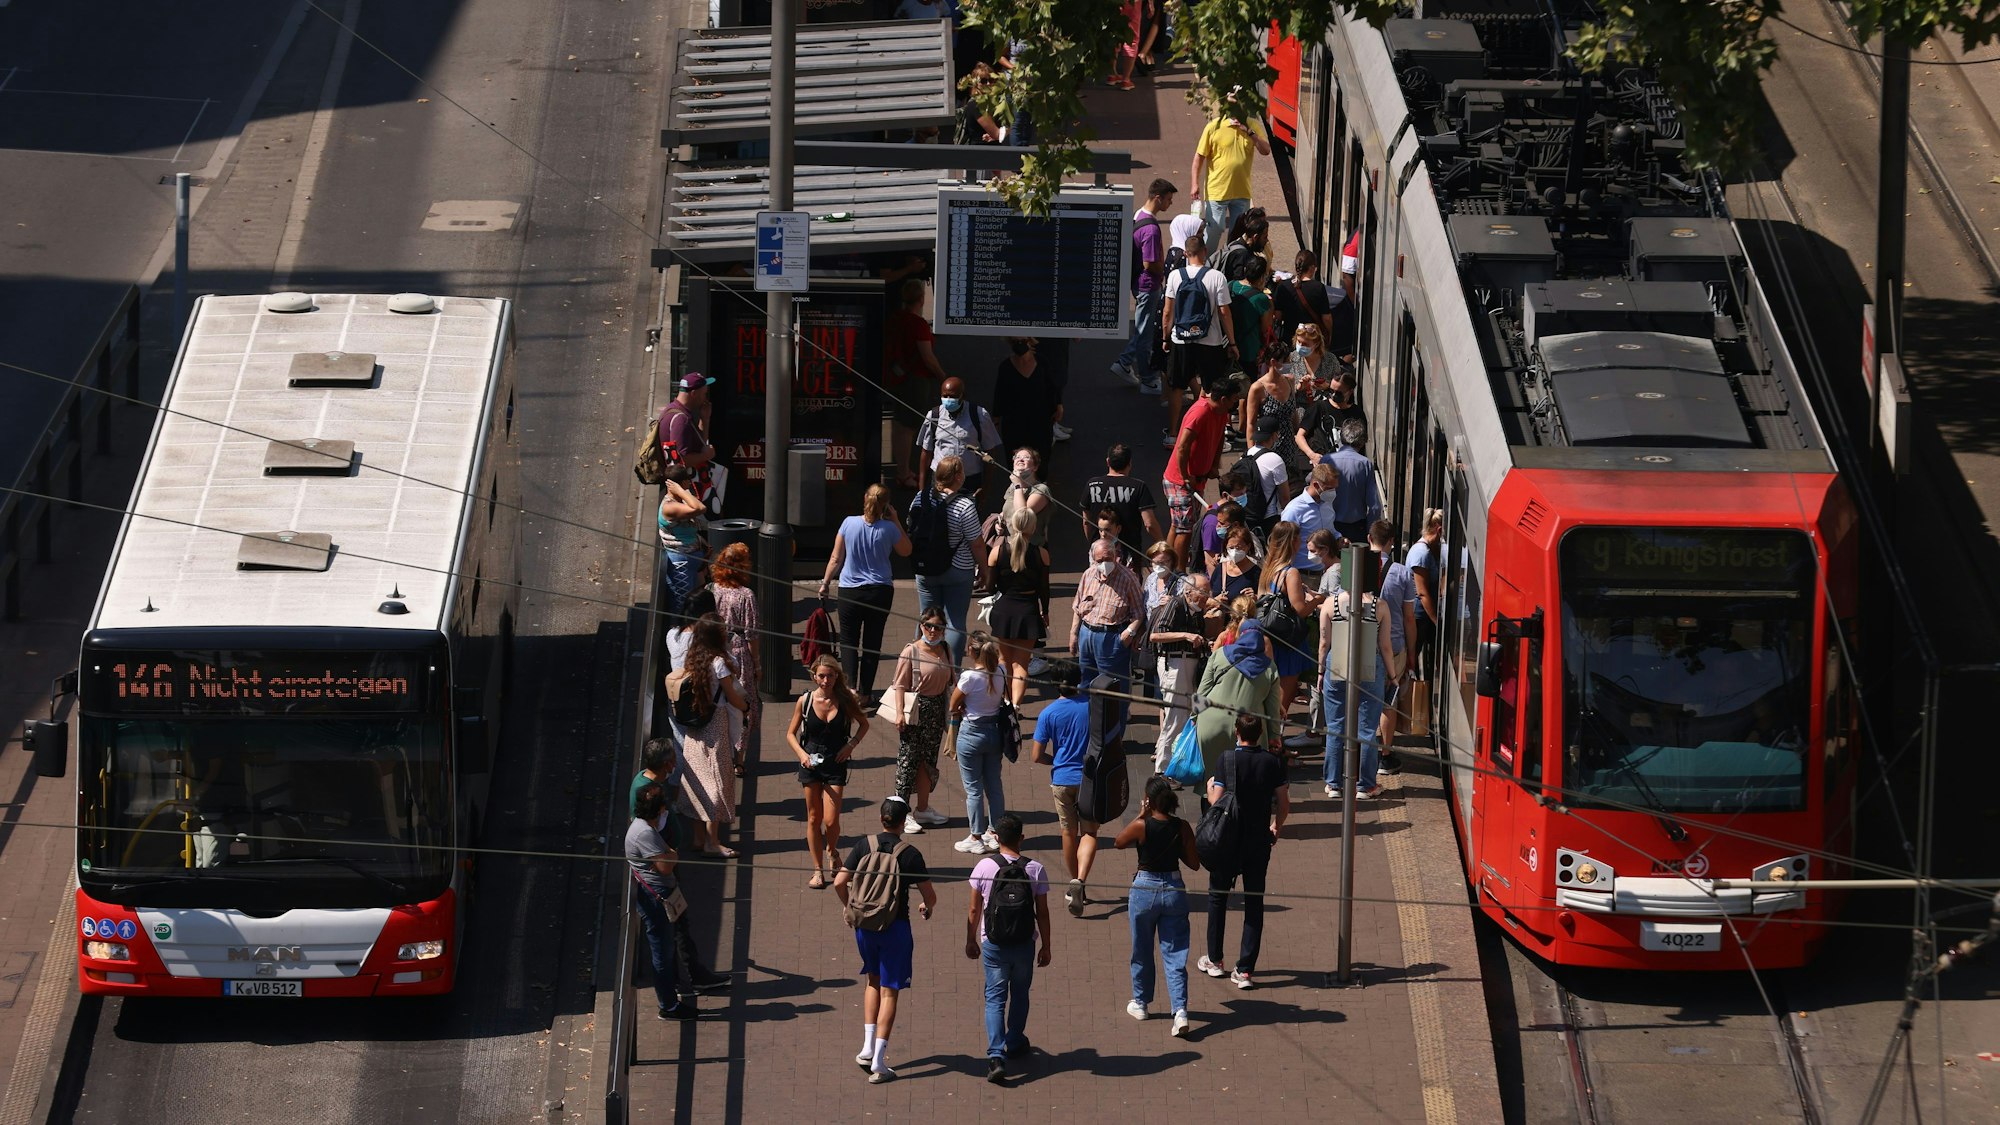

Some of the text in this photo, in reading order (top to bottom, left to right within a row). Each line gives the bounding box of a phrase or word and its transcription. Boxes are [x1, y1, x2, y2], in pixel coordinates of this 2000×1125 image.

[975, 237, 1013, 245] Königsforst
[974, 266, 1012, 274] Königsforst
[973, 288, 1011, 296] Königsforst
[972, 310, 1010, 318] Königsforst
[825, 466, 844, 480] ÖLN
[1090, 486, 1135, 503] RAW
[190, 664, 262, 698] Nicht
[153, 926, 168, 934] VRS
[1661, 934, 1705, 946] 4022
[228, 946, 301, 961] MAN
[236, 982, 244, 994] K
